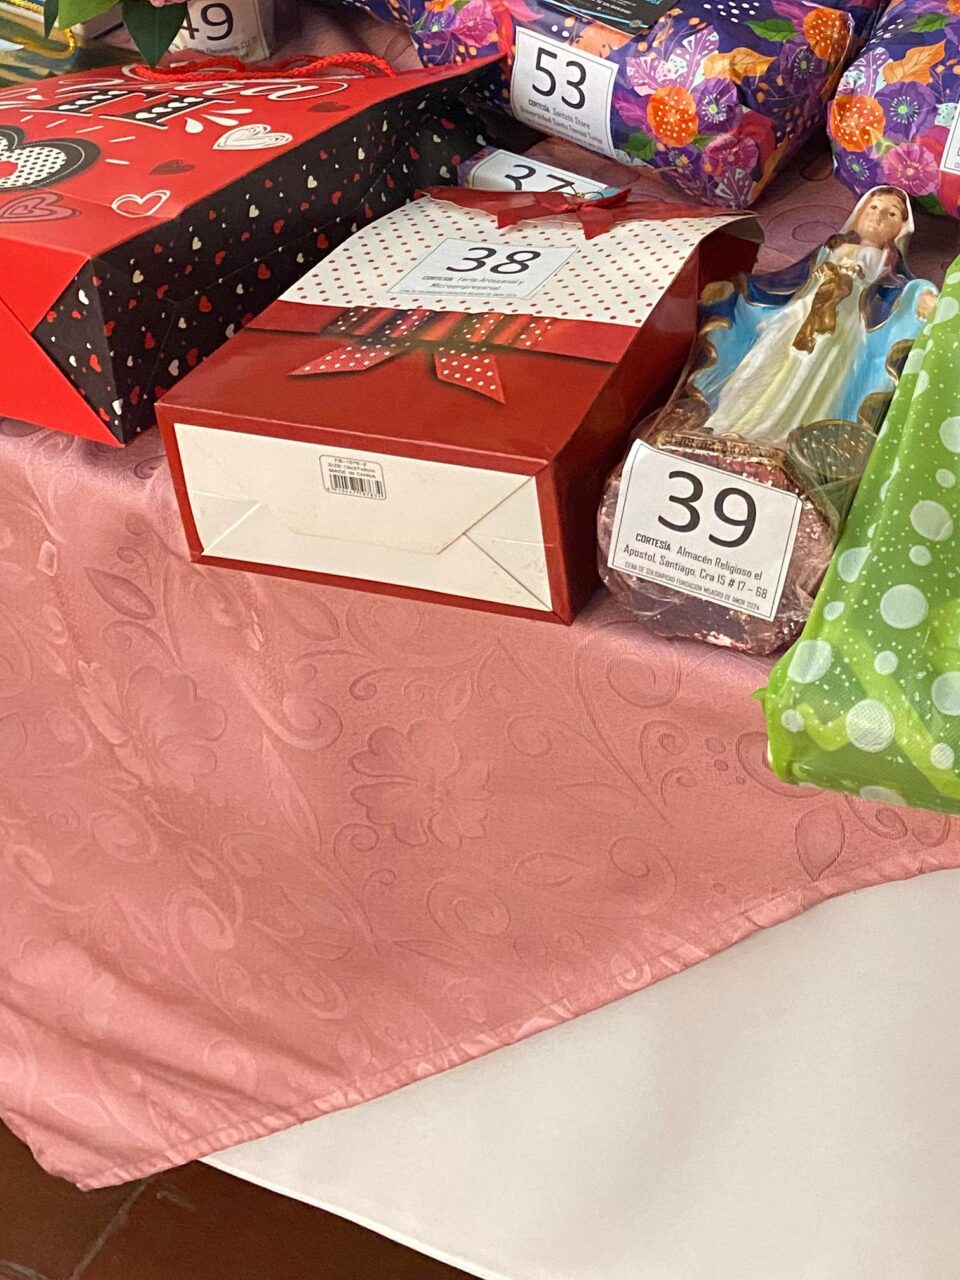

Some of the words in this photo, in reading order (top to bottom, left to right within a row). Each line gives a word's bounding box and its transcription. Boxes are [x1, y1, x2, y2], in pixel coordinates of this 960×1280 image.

[531, 46, 587, 110] 53
[446, 246, 541, 275] 38
[657, 470, 757, 548] 39
[677, 546, 712, 566] Almacén
[714, 557, 752, 579] Religioso
[754, 571, 763, 581] el
[699, 568, 715, 582] Cra
[717, 574, 726, 585] 15
[727, 578, 735, 588] #
[737, 581, 746, 592] 17
[755, 586, 768, 599] 68
